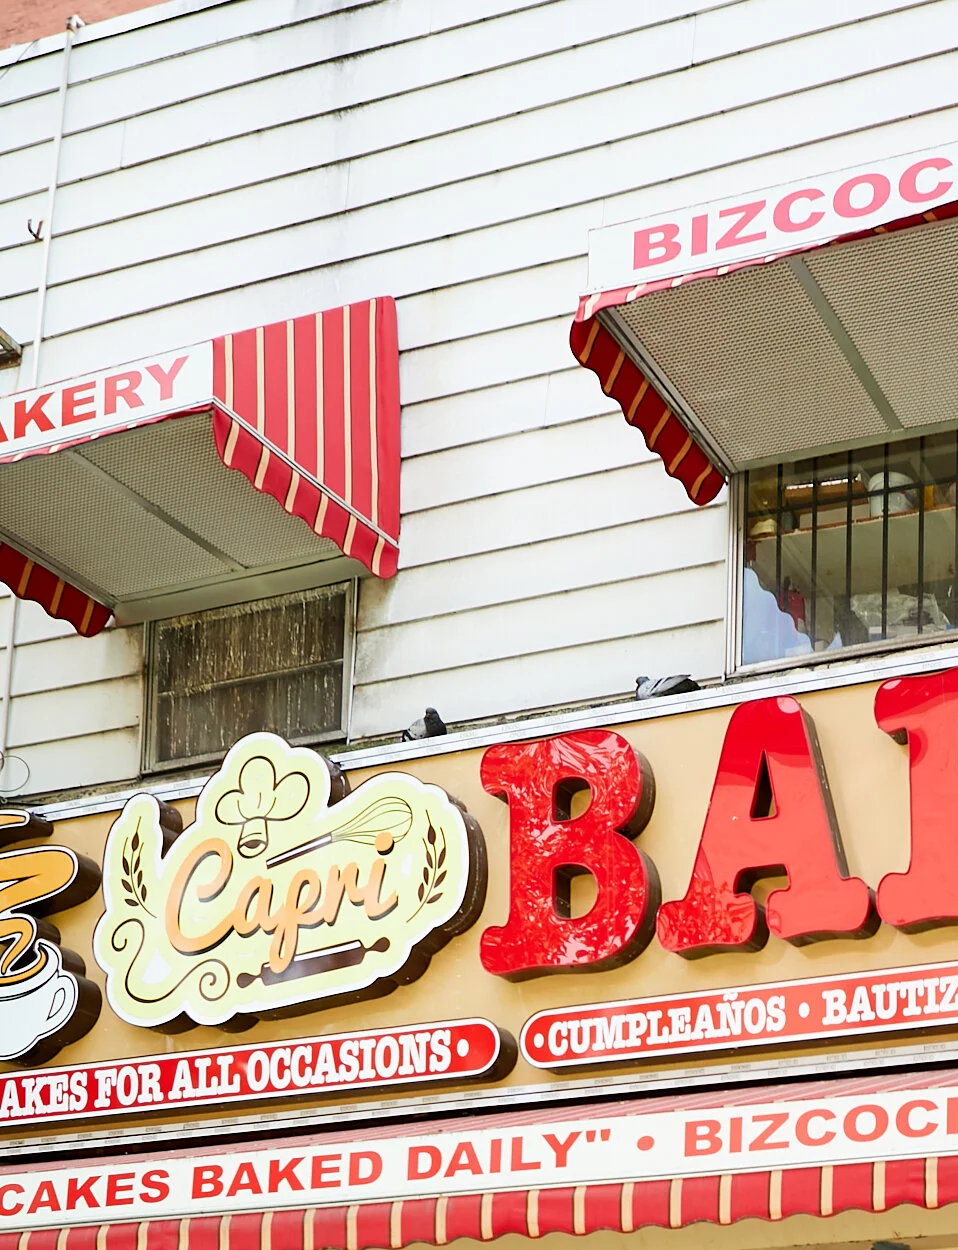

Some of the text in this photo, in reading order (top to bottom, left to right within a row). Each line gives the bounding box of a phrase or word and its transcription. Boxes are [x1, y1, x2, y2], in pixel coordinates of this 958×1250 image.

[0, 355, 190, 444] KERY
[165, 832, 399, 972] Capri
[547, 990, 787, 1056] CUMPLEAÑOS
[0, 1029, 452, 1119] AKES FOR ALL OCCASIONS
[0, 1169, 171, 1217] CAKES
[192, 1150, 384, 1200] BAKED
